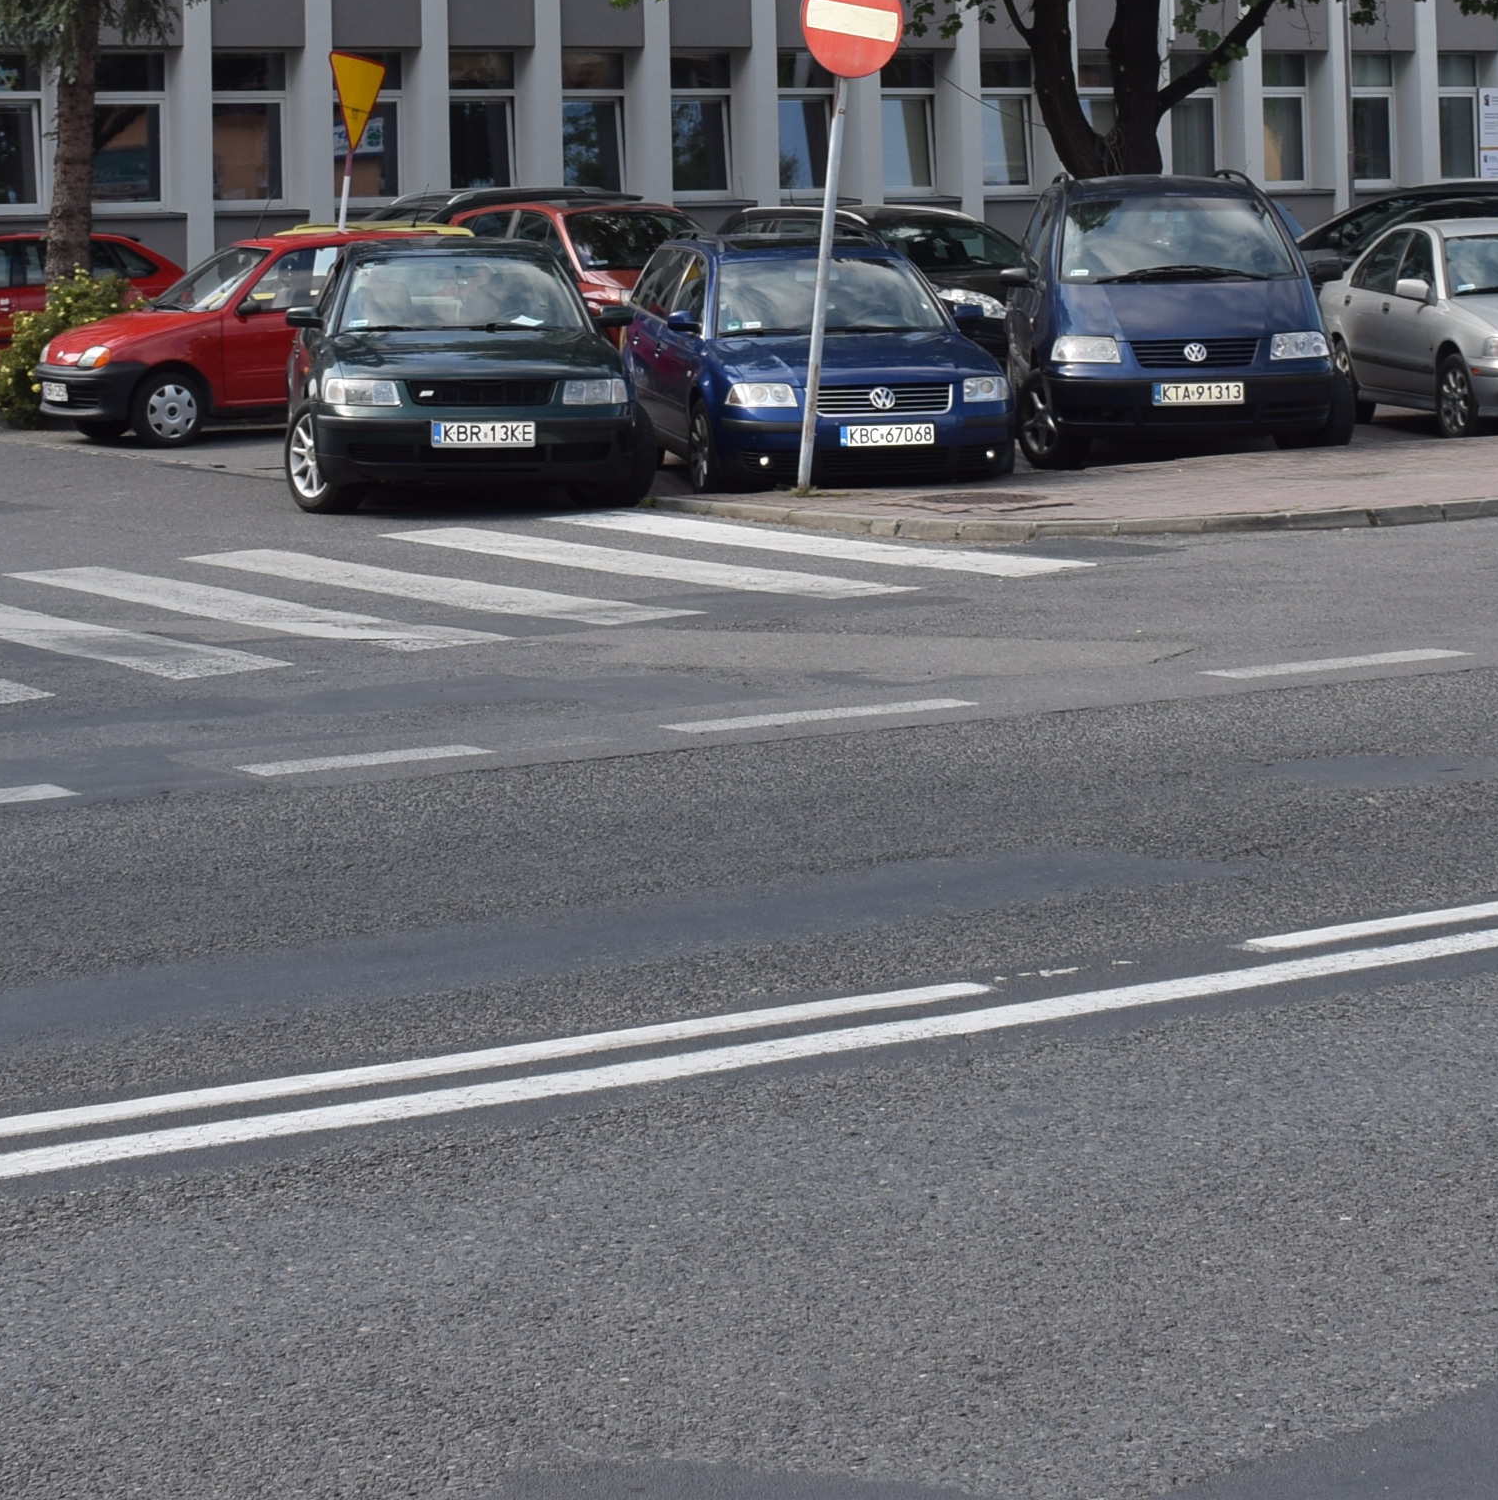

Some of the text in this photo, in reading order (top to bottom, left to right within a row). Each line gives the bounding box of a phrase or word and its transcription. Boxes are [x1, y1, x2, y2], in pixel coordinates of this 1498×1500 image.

[1162, 384, 1241, 401] KTA 91313
[443, 424, 482, 442] KBR
[490, 424, 533, 442] 13KE
[849, 427, 880, 444] KBC
[885, 425, 933, 444] 67068
